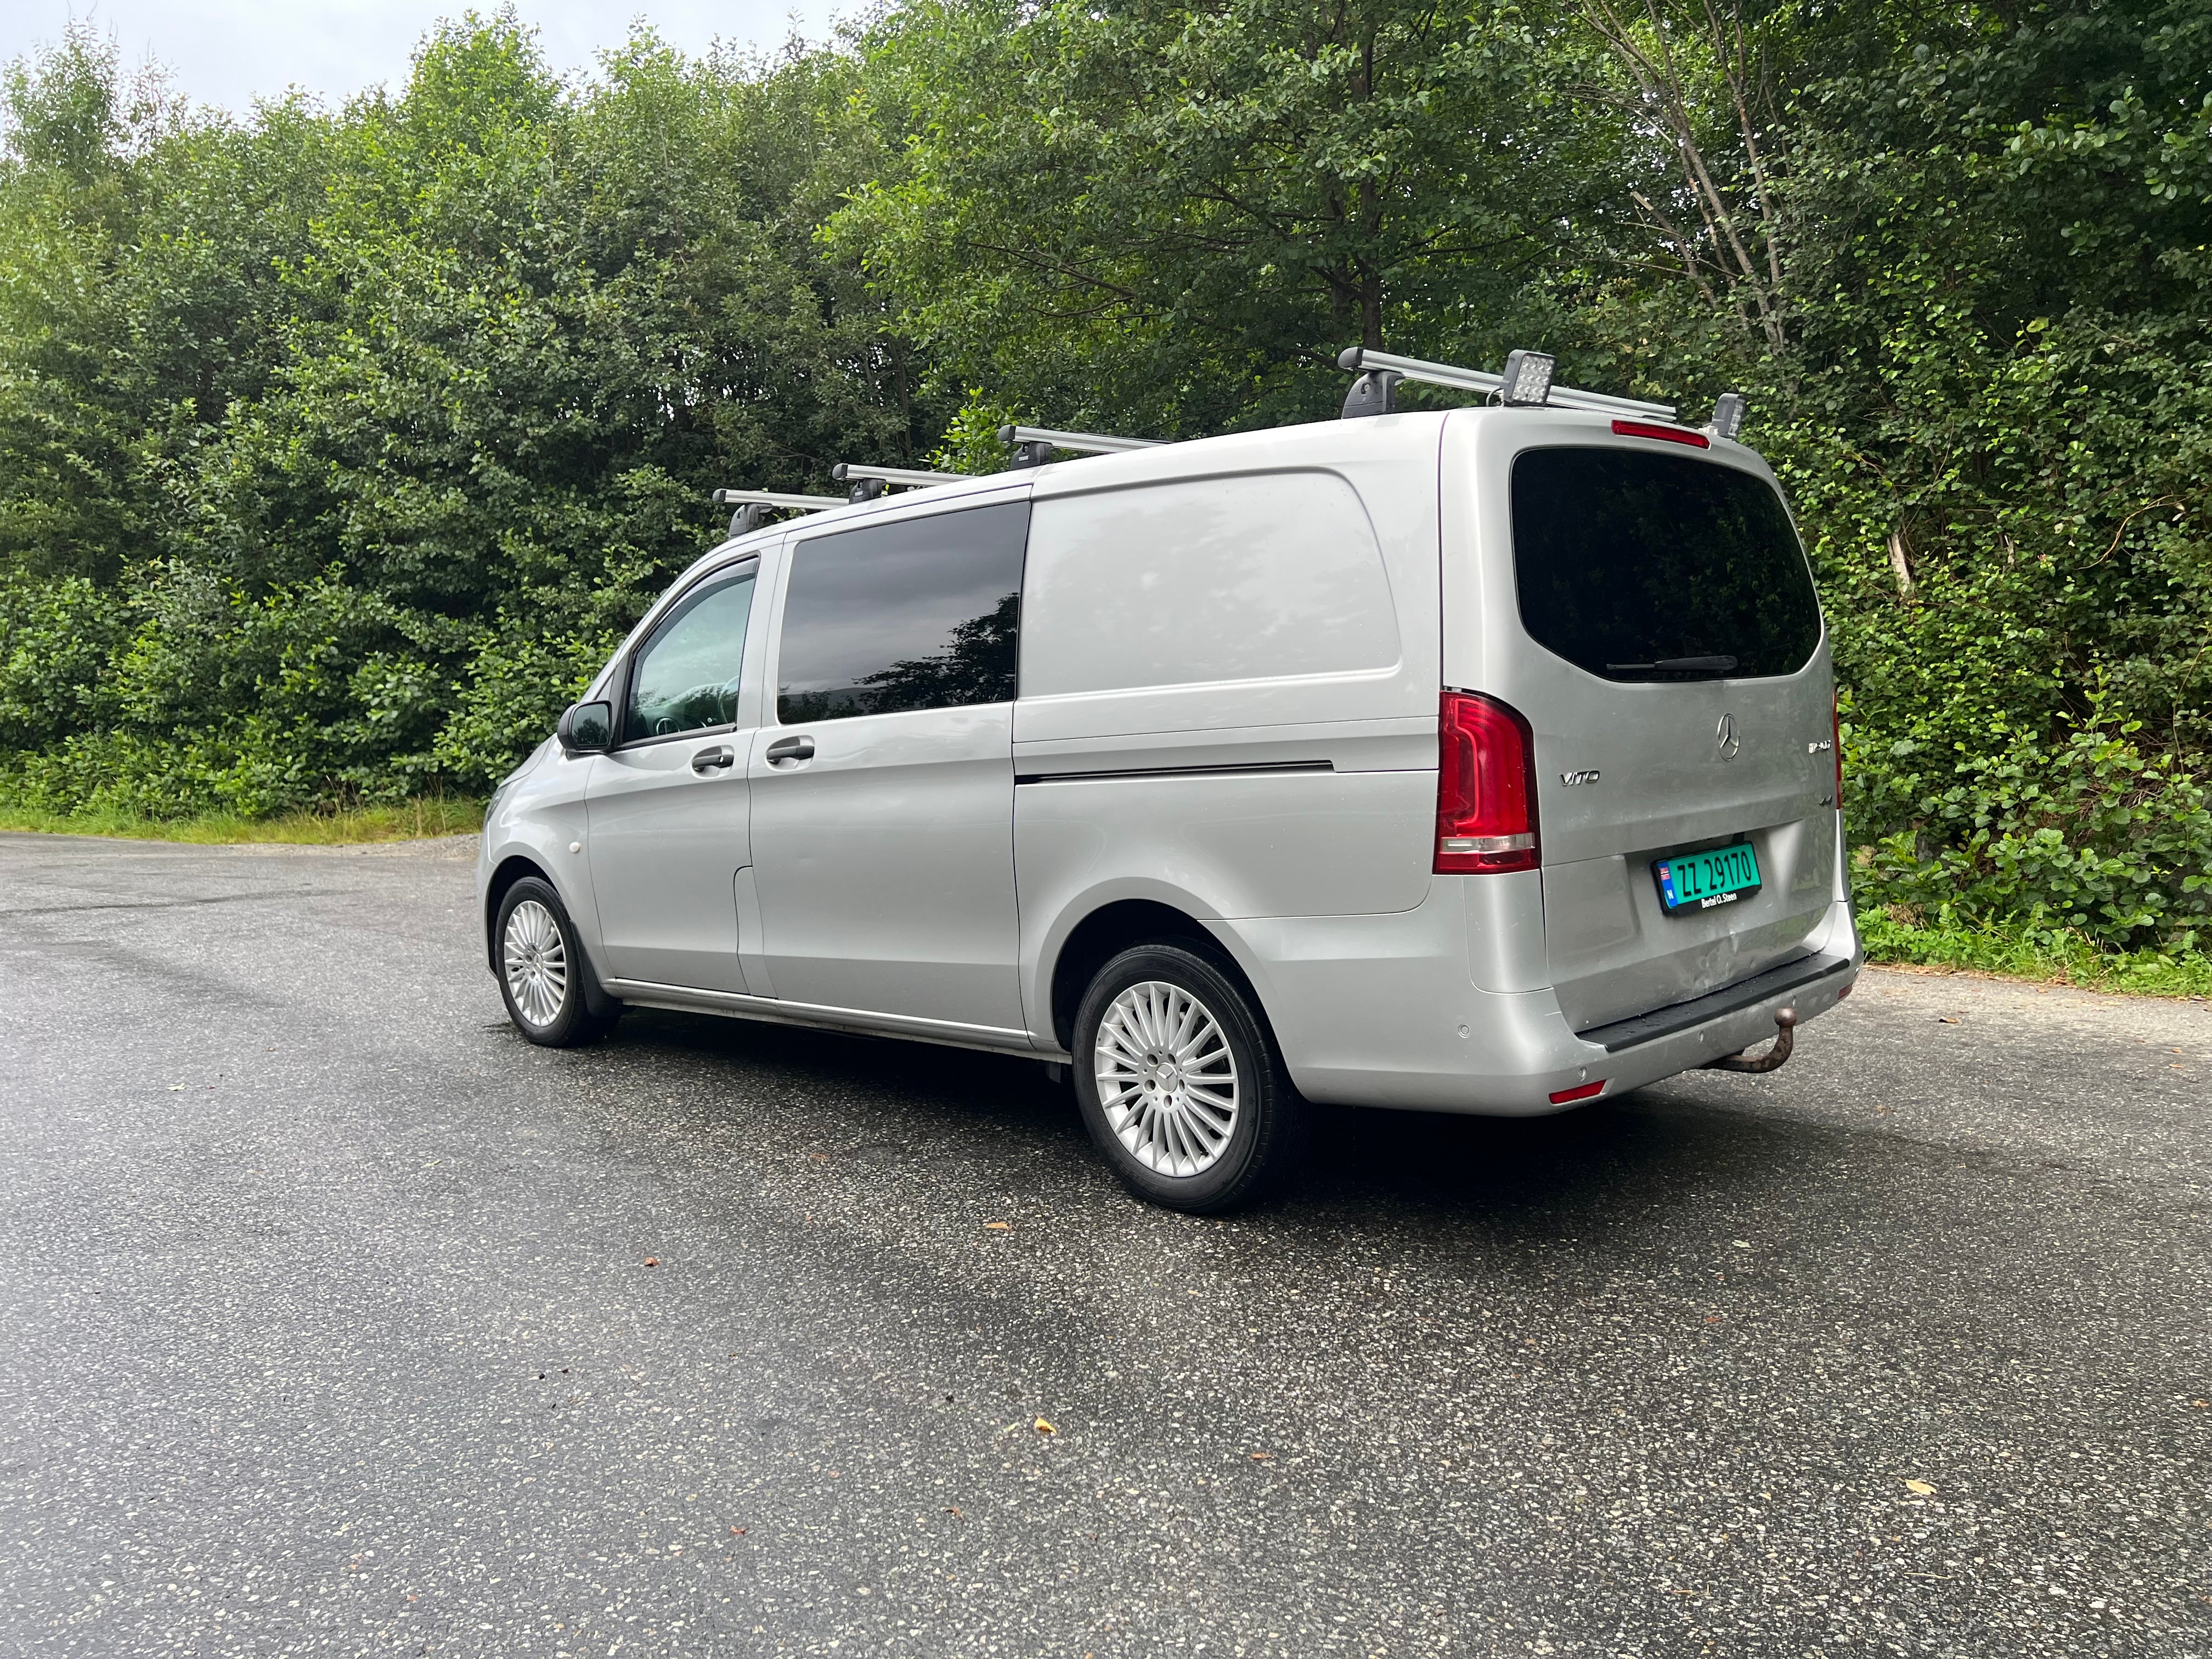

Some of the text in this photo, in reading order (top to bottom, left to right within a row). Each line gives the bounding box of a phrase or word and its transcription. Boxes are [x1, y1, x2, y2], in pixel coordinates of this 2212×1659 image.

[1559, 770, 1600, 786] VITO
[1677, 851, 1751, 897] ZZ 29170
[1667, 889, 1674, 899] N
[1701, 893, 1737, 909] Bertel O. Steen
